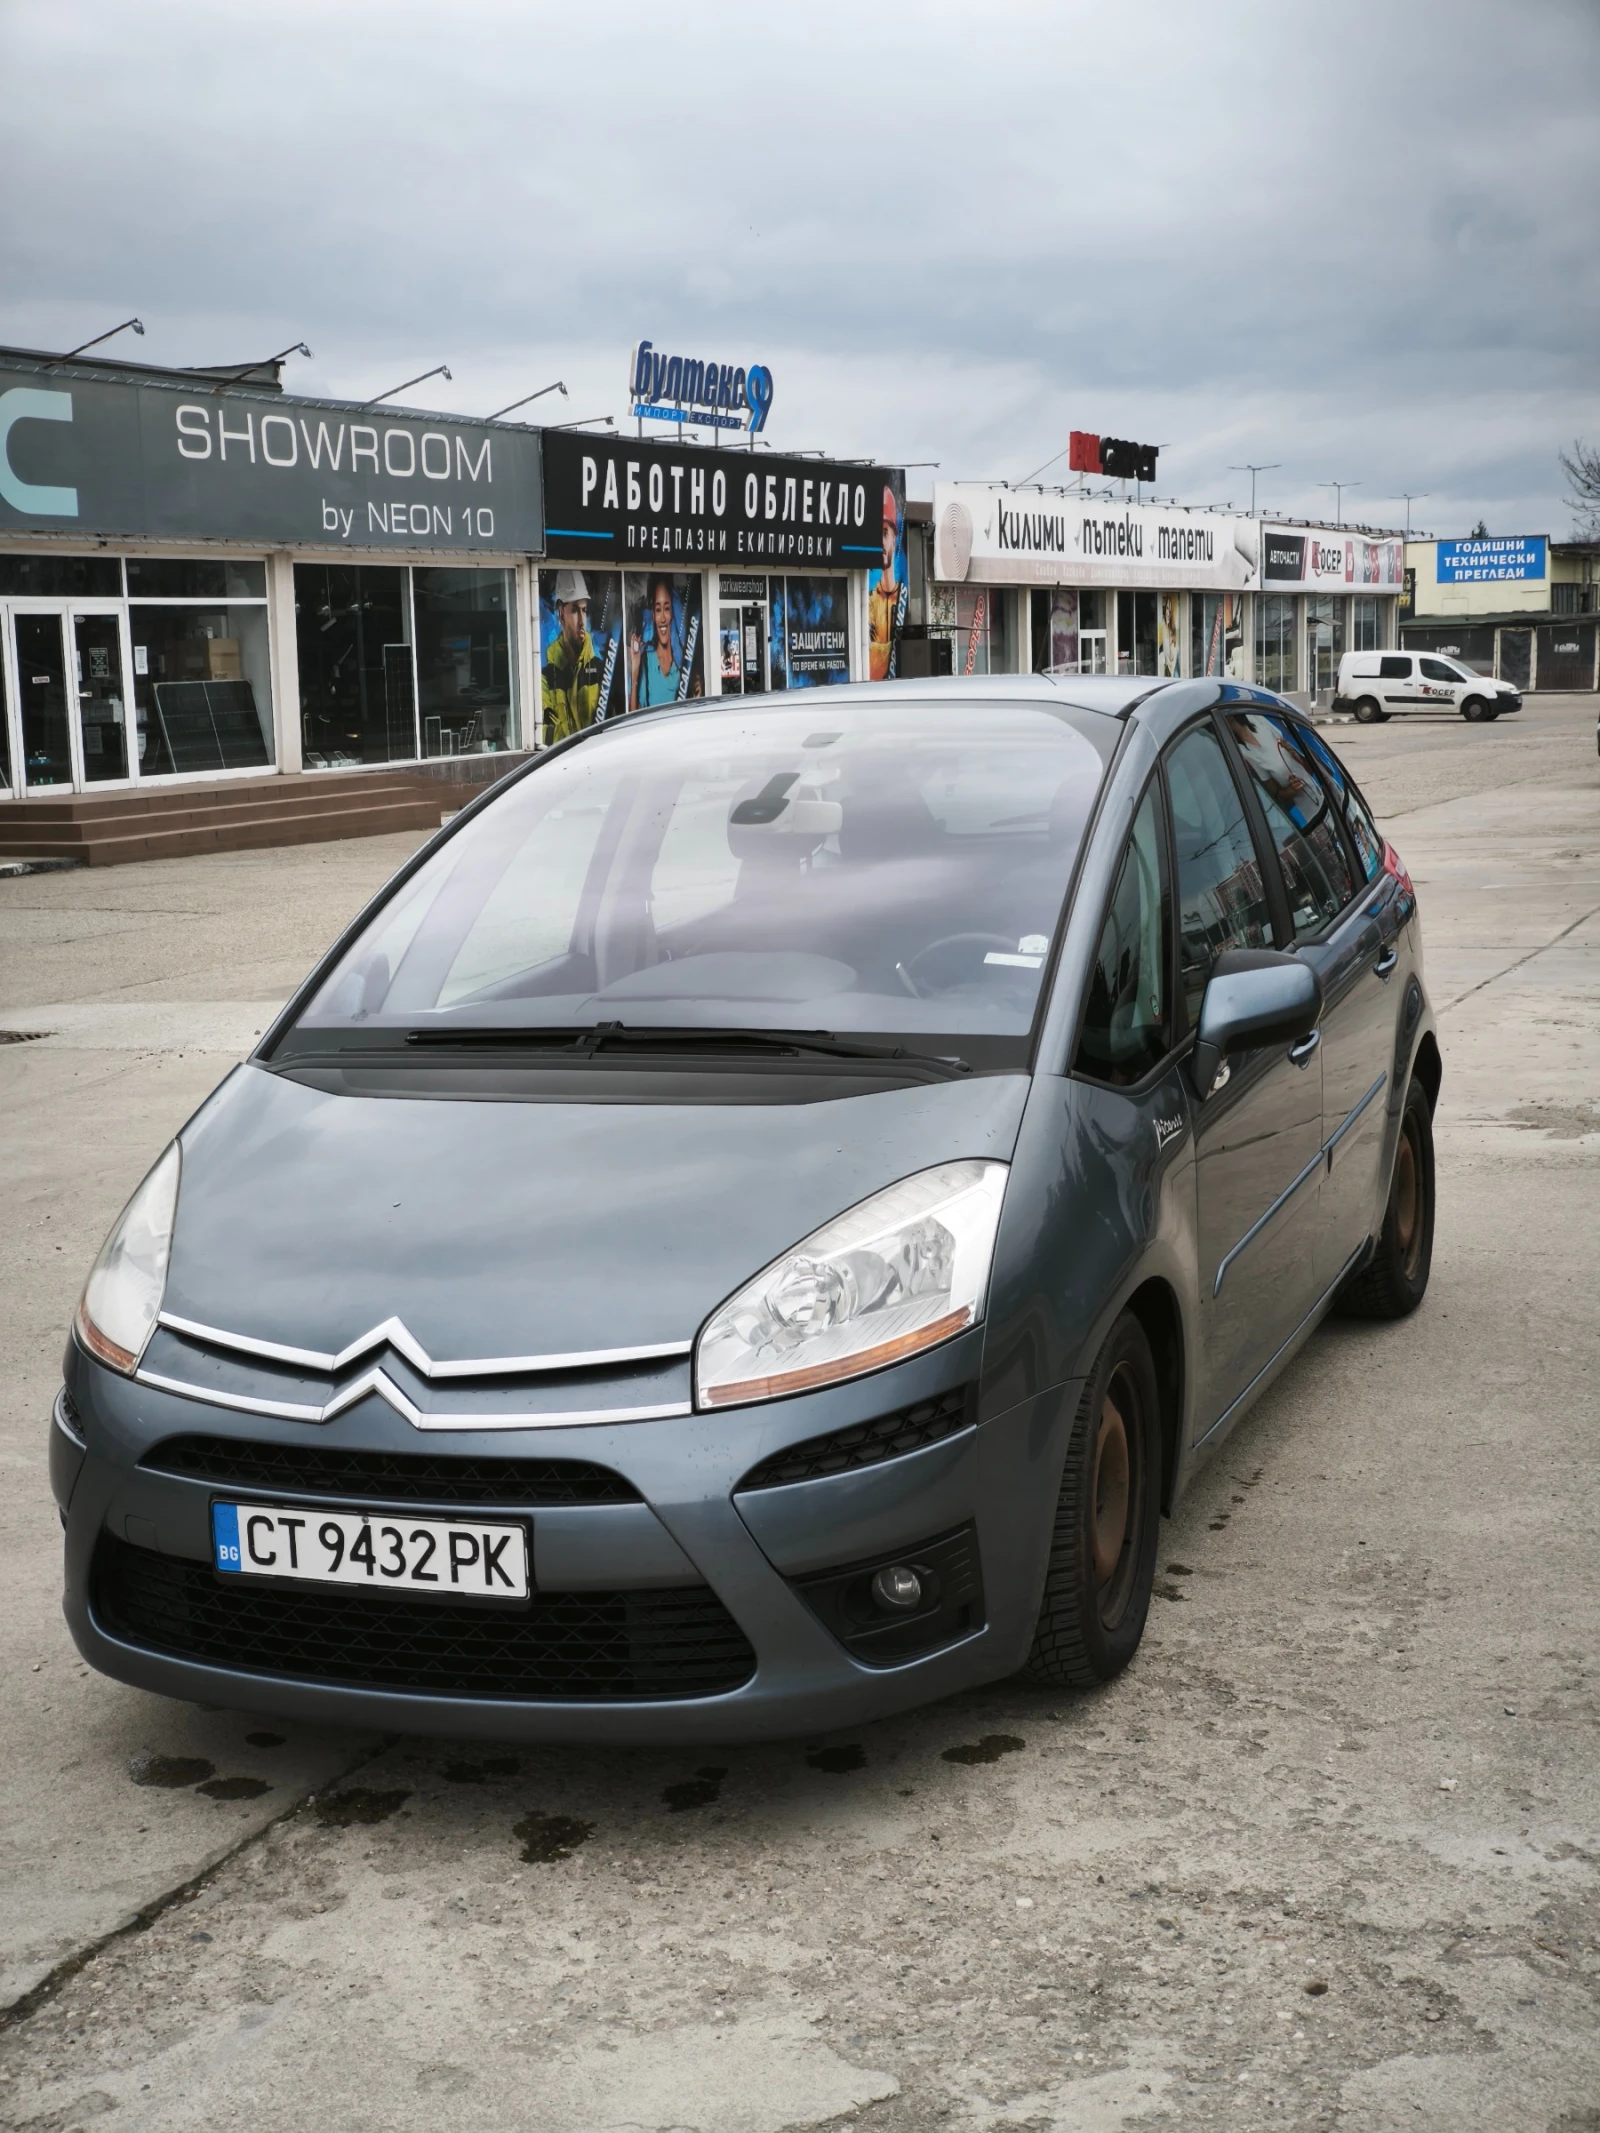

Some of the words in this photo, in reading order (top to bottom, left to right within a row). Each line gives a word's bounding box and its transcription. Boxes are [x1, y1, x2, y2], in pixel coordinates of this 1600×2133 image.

[635, 404, 684, 421] ИМПОРТ
[689, 411, 741, 428] ЕКСПОРТ
[176, 405, 493, 483] SHOWROOM
[582, 456, 726, 516] РАБОТНО
[745, 472, 865, 527] ОБЛЕКЛО
[322, 499, 353, 538] by
[368, 501, 452, 536] NEON
[461, 508, 494, 537] 10
[998, 499, 1064, 551] килими
[1083, 512, 1143, 557] пътеки
[1158, 525, 1213, 561] тапети
[628, 525, 726, 551] ПРЕДПАЗНИ
[738, 531, 832, 557] ЕКИПИРОВКИ
[1455, 540, 1525, 553] ГОДИШНИ
[1270, 550, 1299, 565] АВТОЧАСТИ
[1444, 553, 1535, 567] ТЕХНИЧЕСКИ
[1454, 567, 1525, 580] ПРЕГЛЕДИ
[684, 615, 699, 662] WEAR
[791, 632, 845, 652] ЗАЩИТЕНИ
[792, 662, 799, 671] ПО
[801, 661, 818, 671] ВРЕМЕ
[819, 661, 826, 670] НА
[827, 660, 845, 670] РАБОТА
[219, 1545, 239, 1562] BG
[246, 1515, 305, 1569] CT
[318, 1521, 438, 1582] 9432
[449, 1531, 515, 1588] PK
